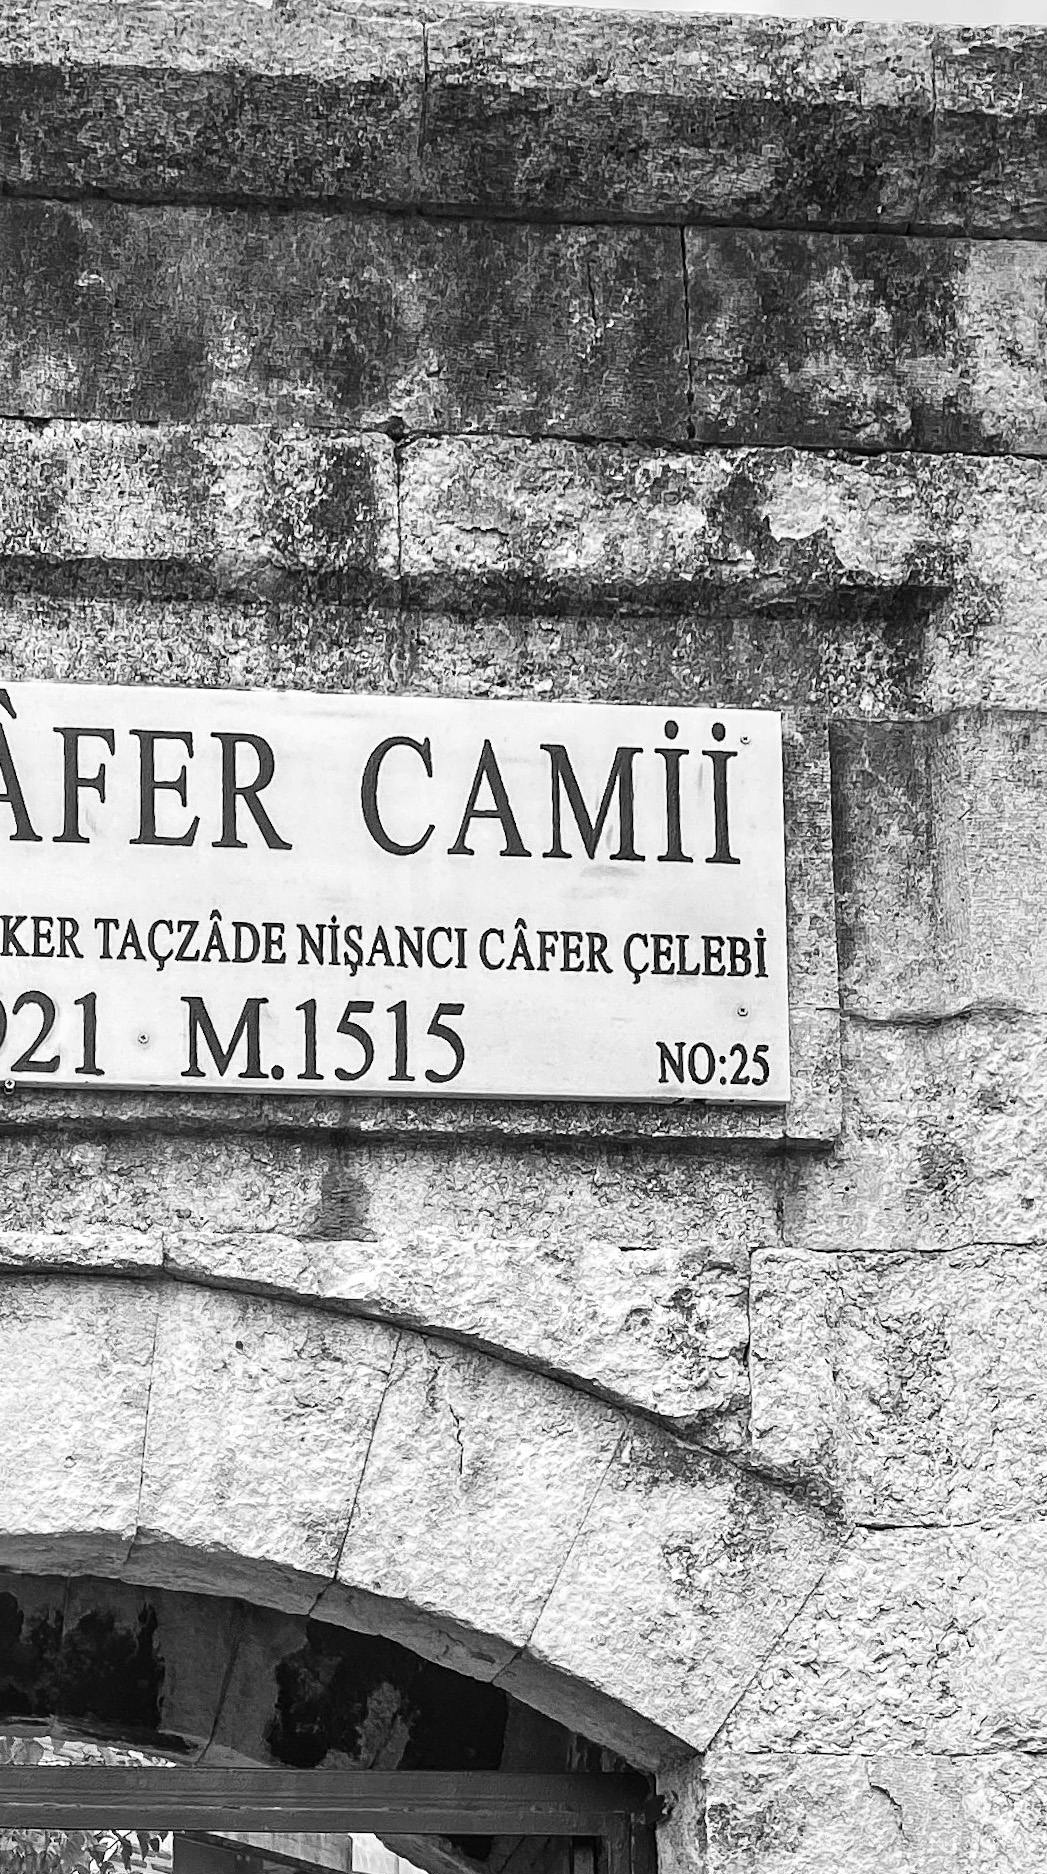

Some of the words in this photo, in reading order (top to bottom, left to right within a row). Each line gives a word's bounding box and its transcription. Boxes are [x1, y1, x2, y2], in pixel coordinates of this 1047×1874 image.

[360, 720, 741, 865] CAMİİ
[94, 909, 287, 972] TAÇZÂDE
[296, 915, 468, 977] NİŞANCI
[479, 917, 614, 974] CÂFER
[623, 927, 770, 985] ÇELEBİ
[180, 996, 465, 1084] M.1515
[655, 1041, 770, 1087] NO:25
